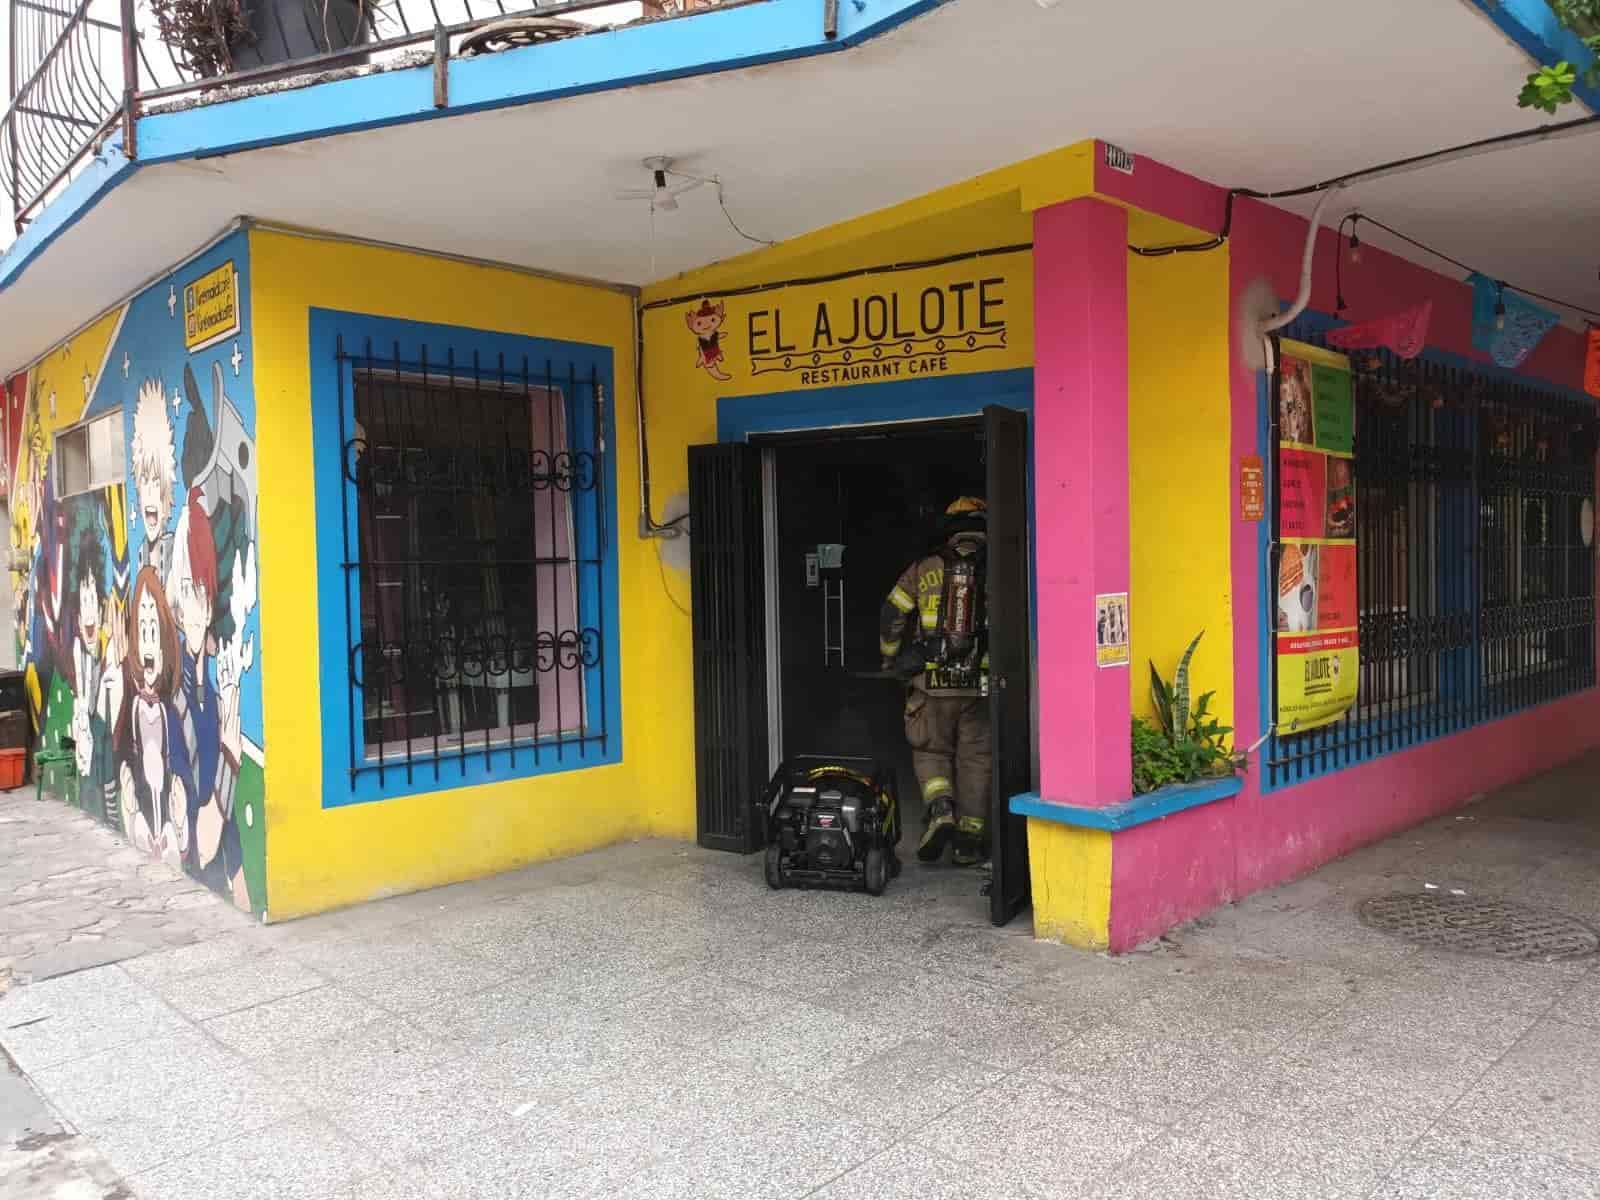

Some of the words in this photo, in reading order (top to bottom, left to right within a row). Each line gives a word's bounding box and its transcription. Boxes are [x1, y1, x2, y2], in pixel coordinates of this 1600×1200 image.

[748, 308, 796, 355] EL
[812, 277, 1005, 348] AJOLOTE
[801, 361, 901, 385] RESTAURANT
[908, 356, 949, 374] CAFE
